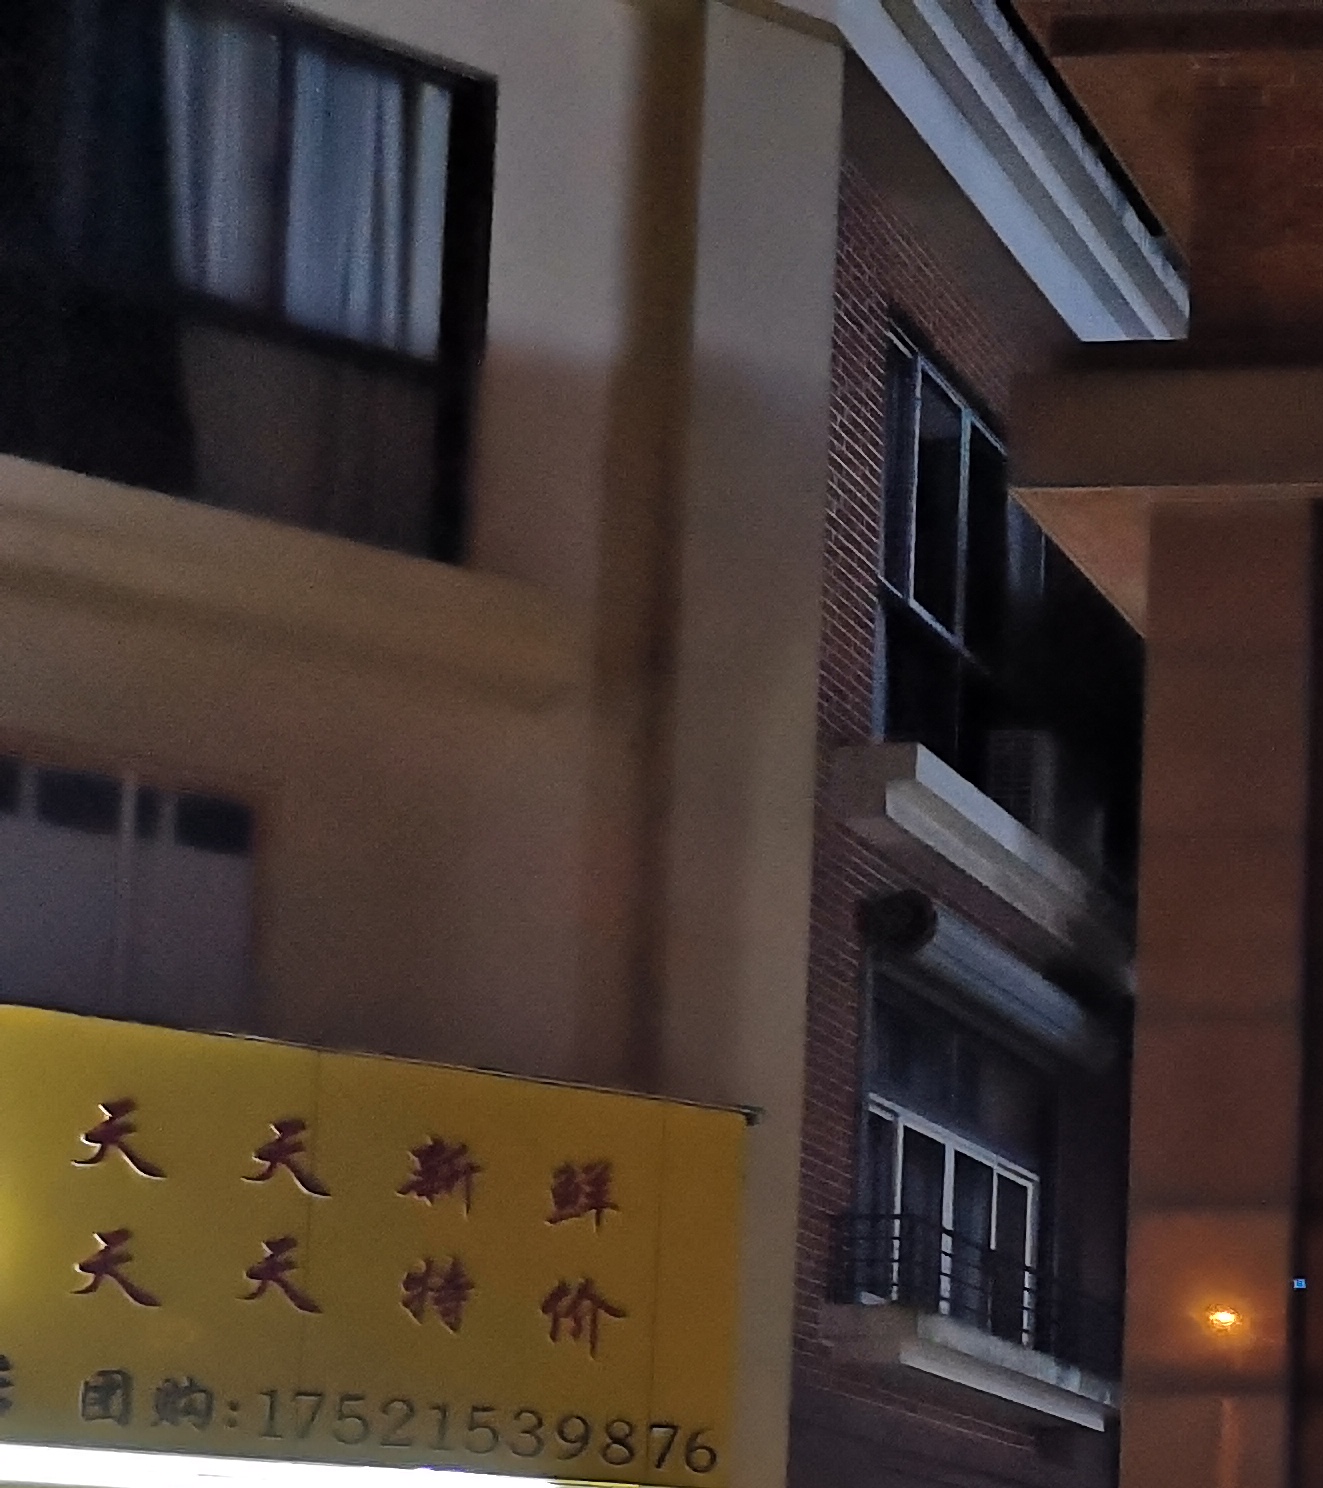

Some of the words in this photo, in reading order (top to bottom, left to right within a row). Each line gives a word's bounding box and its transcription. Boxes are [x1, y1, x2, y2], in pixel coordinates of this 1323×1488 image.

[72, 1097, 619, 1233] 天天新鲜
[72, 1229, 626, 1359] 天天特价
